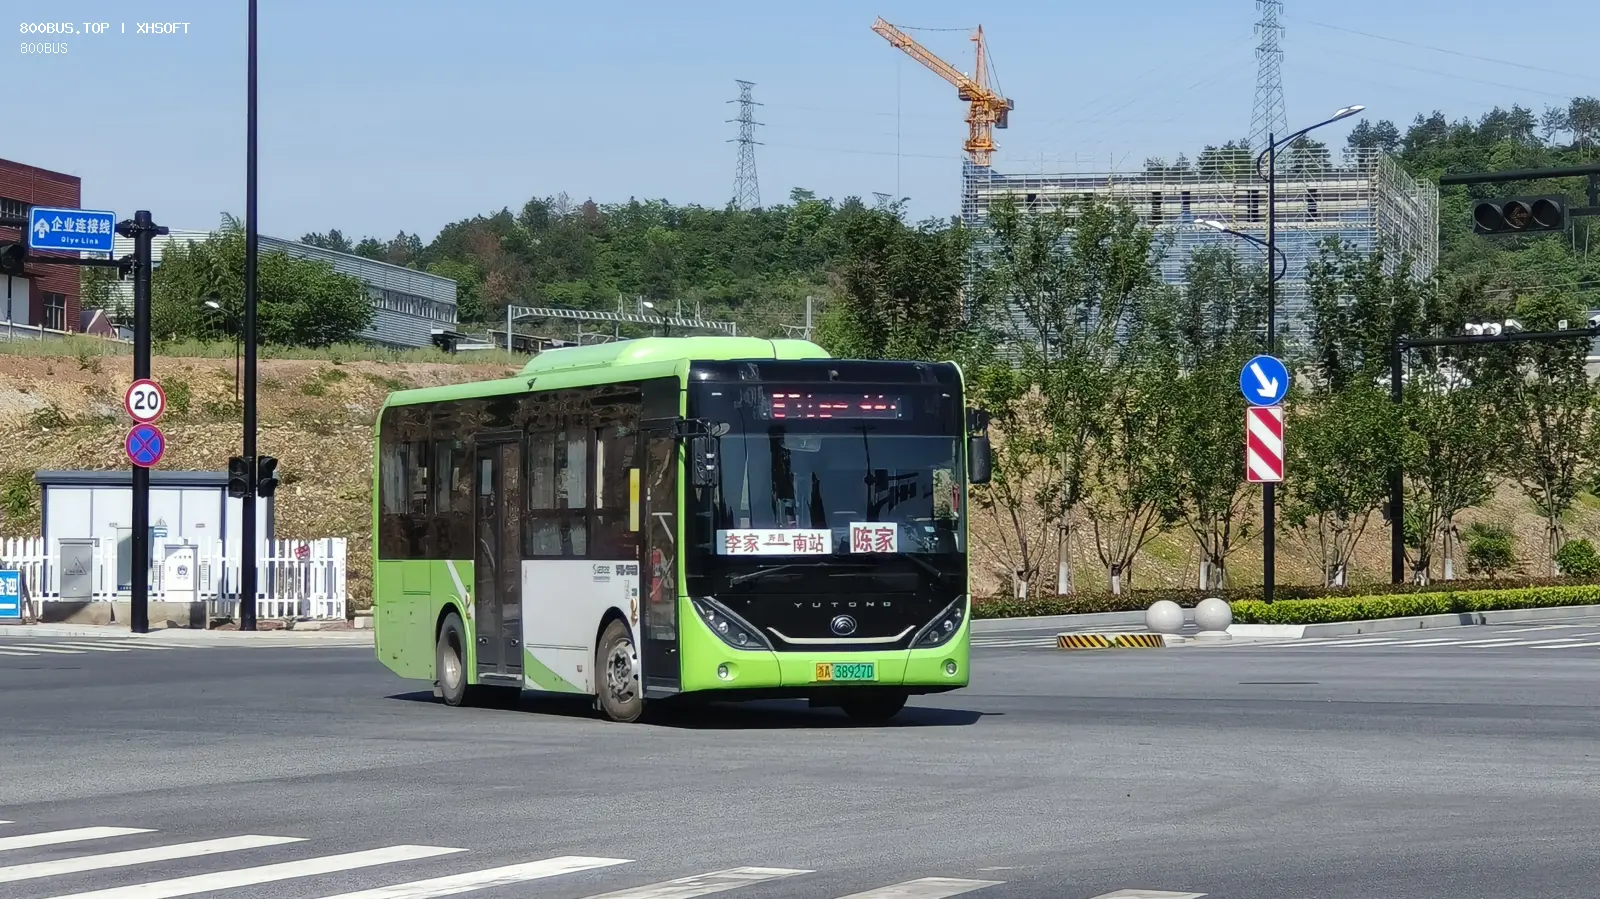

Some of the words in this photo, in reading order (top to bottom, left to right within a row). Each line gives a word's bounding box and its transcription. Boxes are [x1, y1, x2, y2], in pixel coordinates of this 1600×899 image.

[51, 215, 111, 235] 企业连接线
[134, 390, 159, 410] 20
[724, 533, 760, 553] 李家
[791, 533, 825, 553] 南站
[853, 526, 895, 553] 陈家
